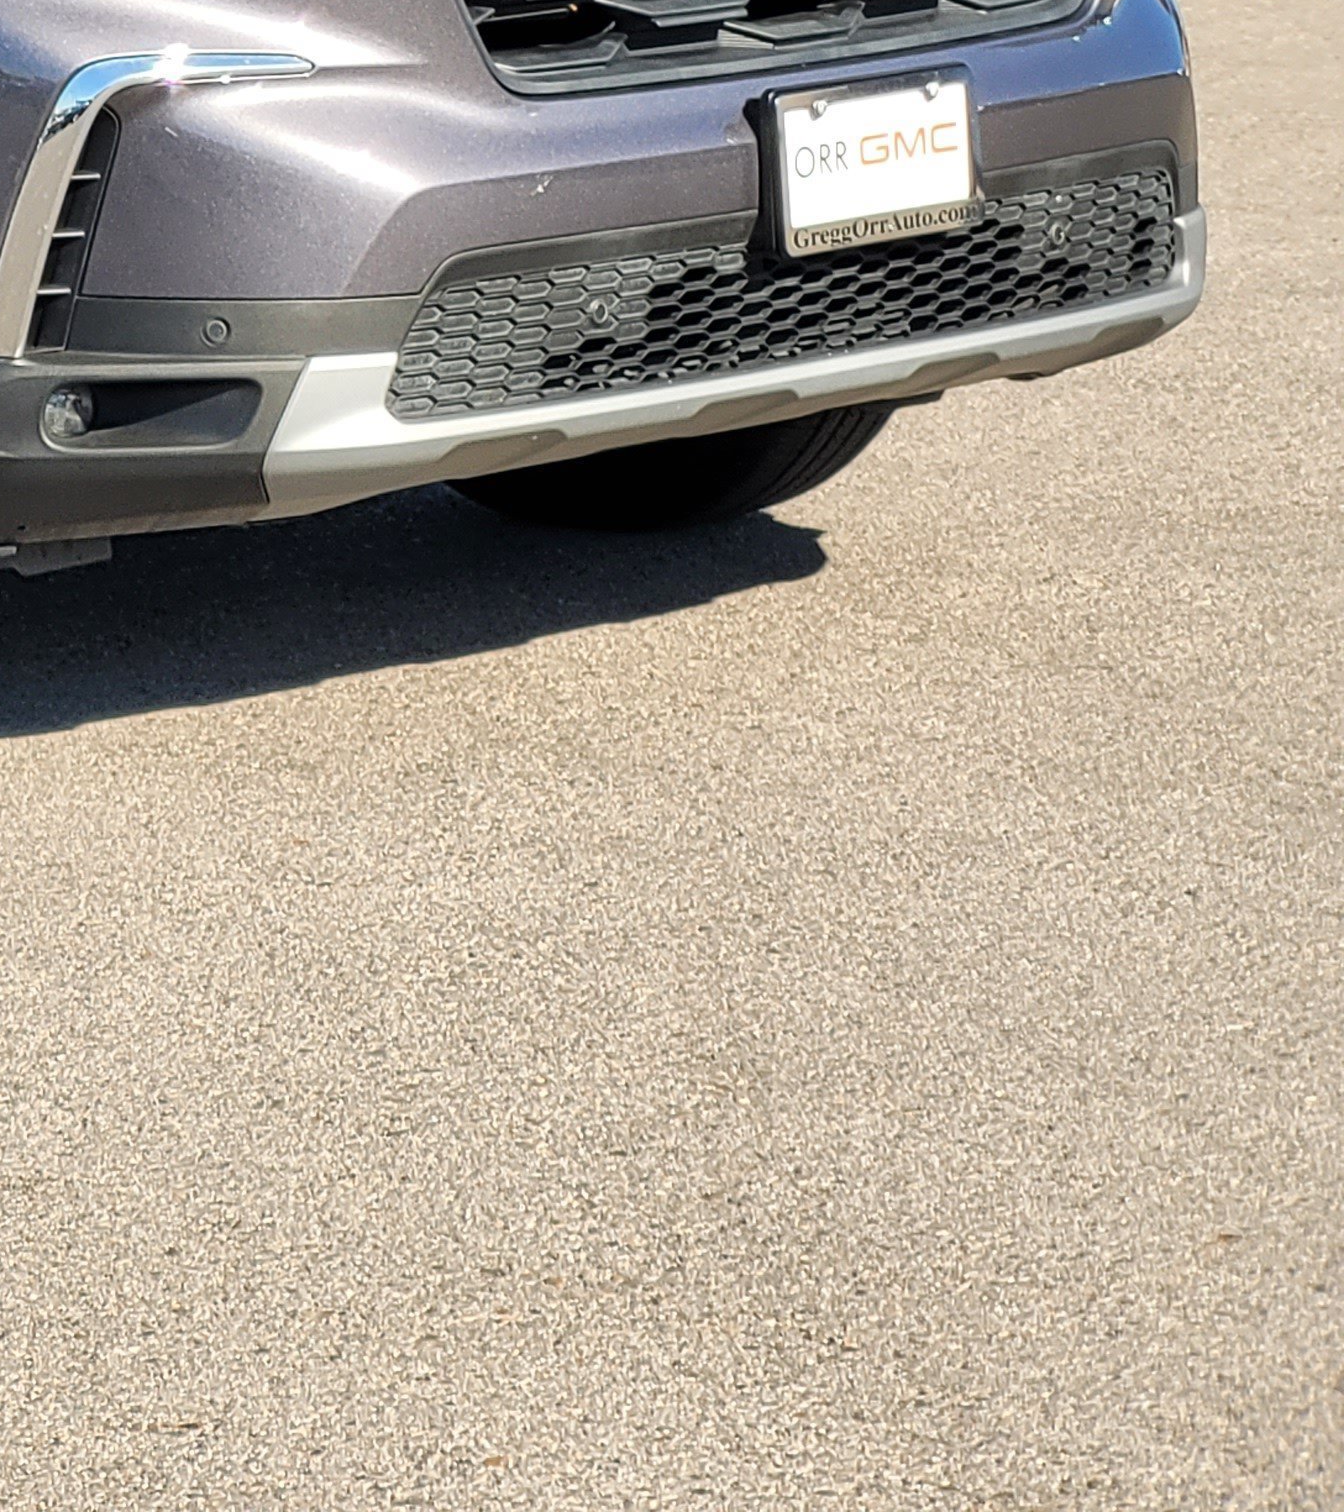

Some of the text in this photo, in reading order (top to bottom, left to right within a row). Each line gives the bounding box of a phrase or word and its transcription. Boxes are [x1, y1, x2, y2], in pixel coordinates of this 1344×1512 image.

[794, 122, 959, 178] ORR GMC
[792, 199, 981, 249] GreggOrrAuto.com
